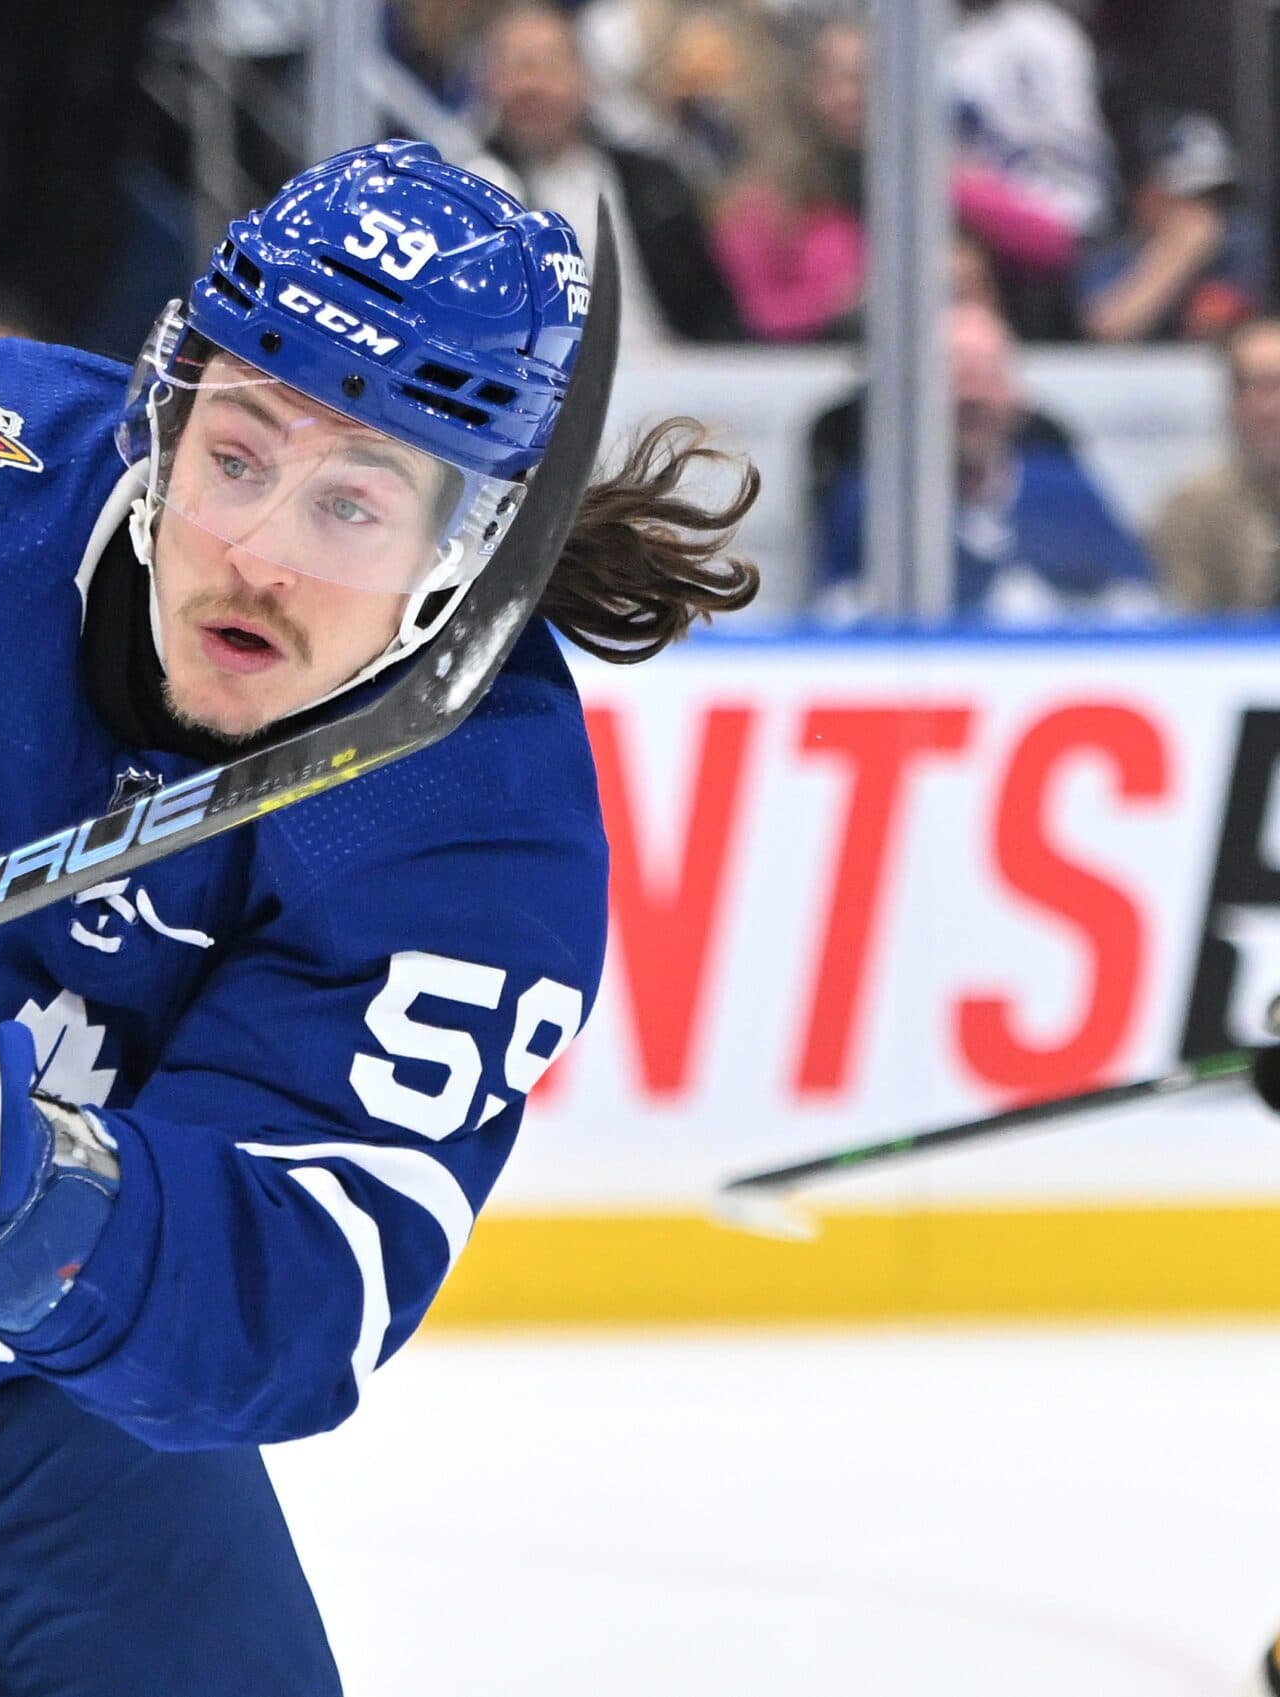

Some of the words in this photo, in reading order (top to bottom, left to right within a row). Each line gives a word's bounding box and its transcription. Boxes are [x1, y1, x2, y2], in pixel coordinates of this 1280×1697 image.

[343, 210, 438, 281] 59
[278, 284, 400, 356] CCM
[349, 950, 584, 1142] 59
